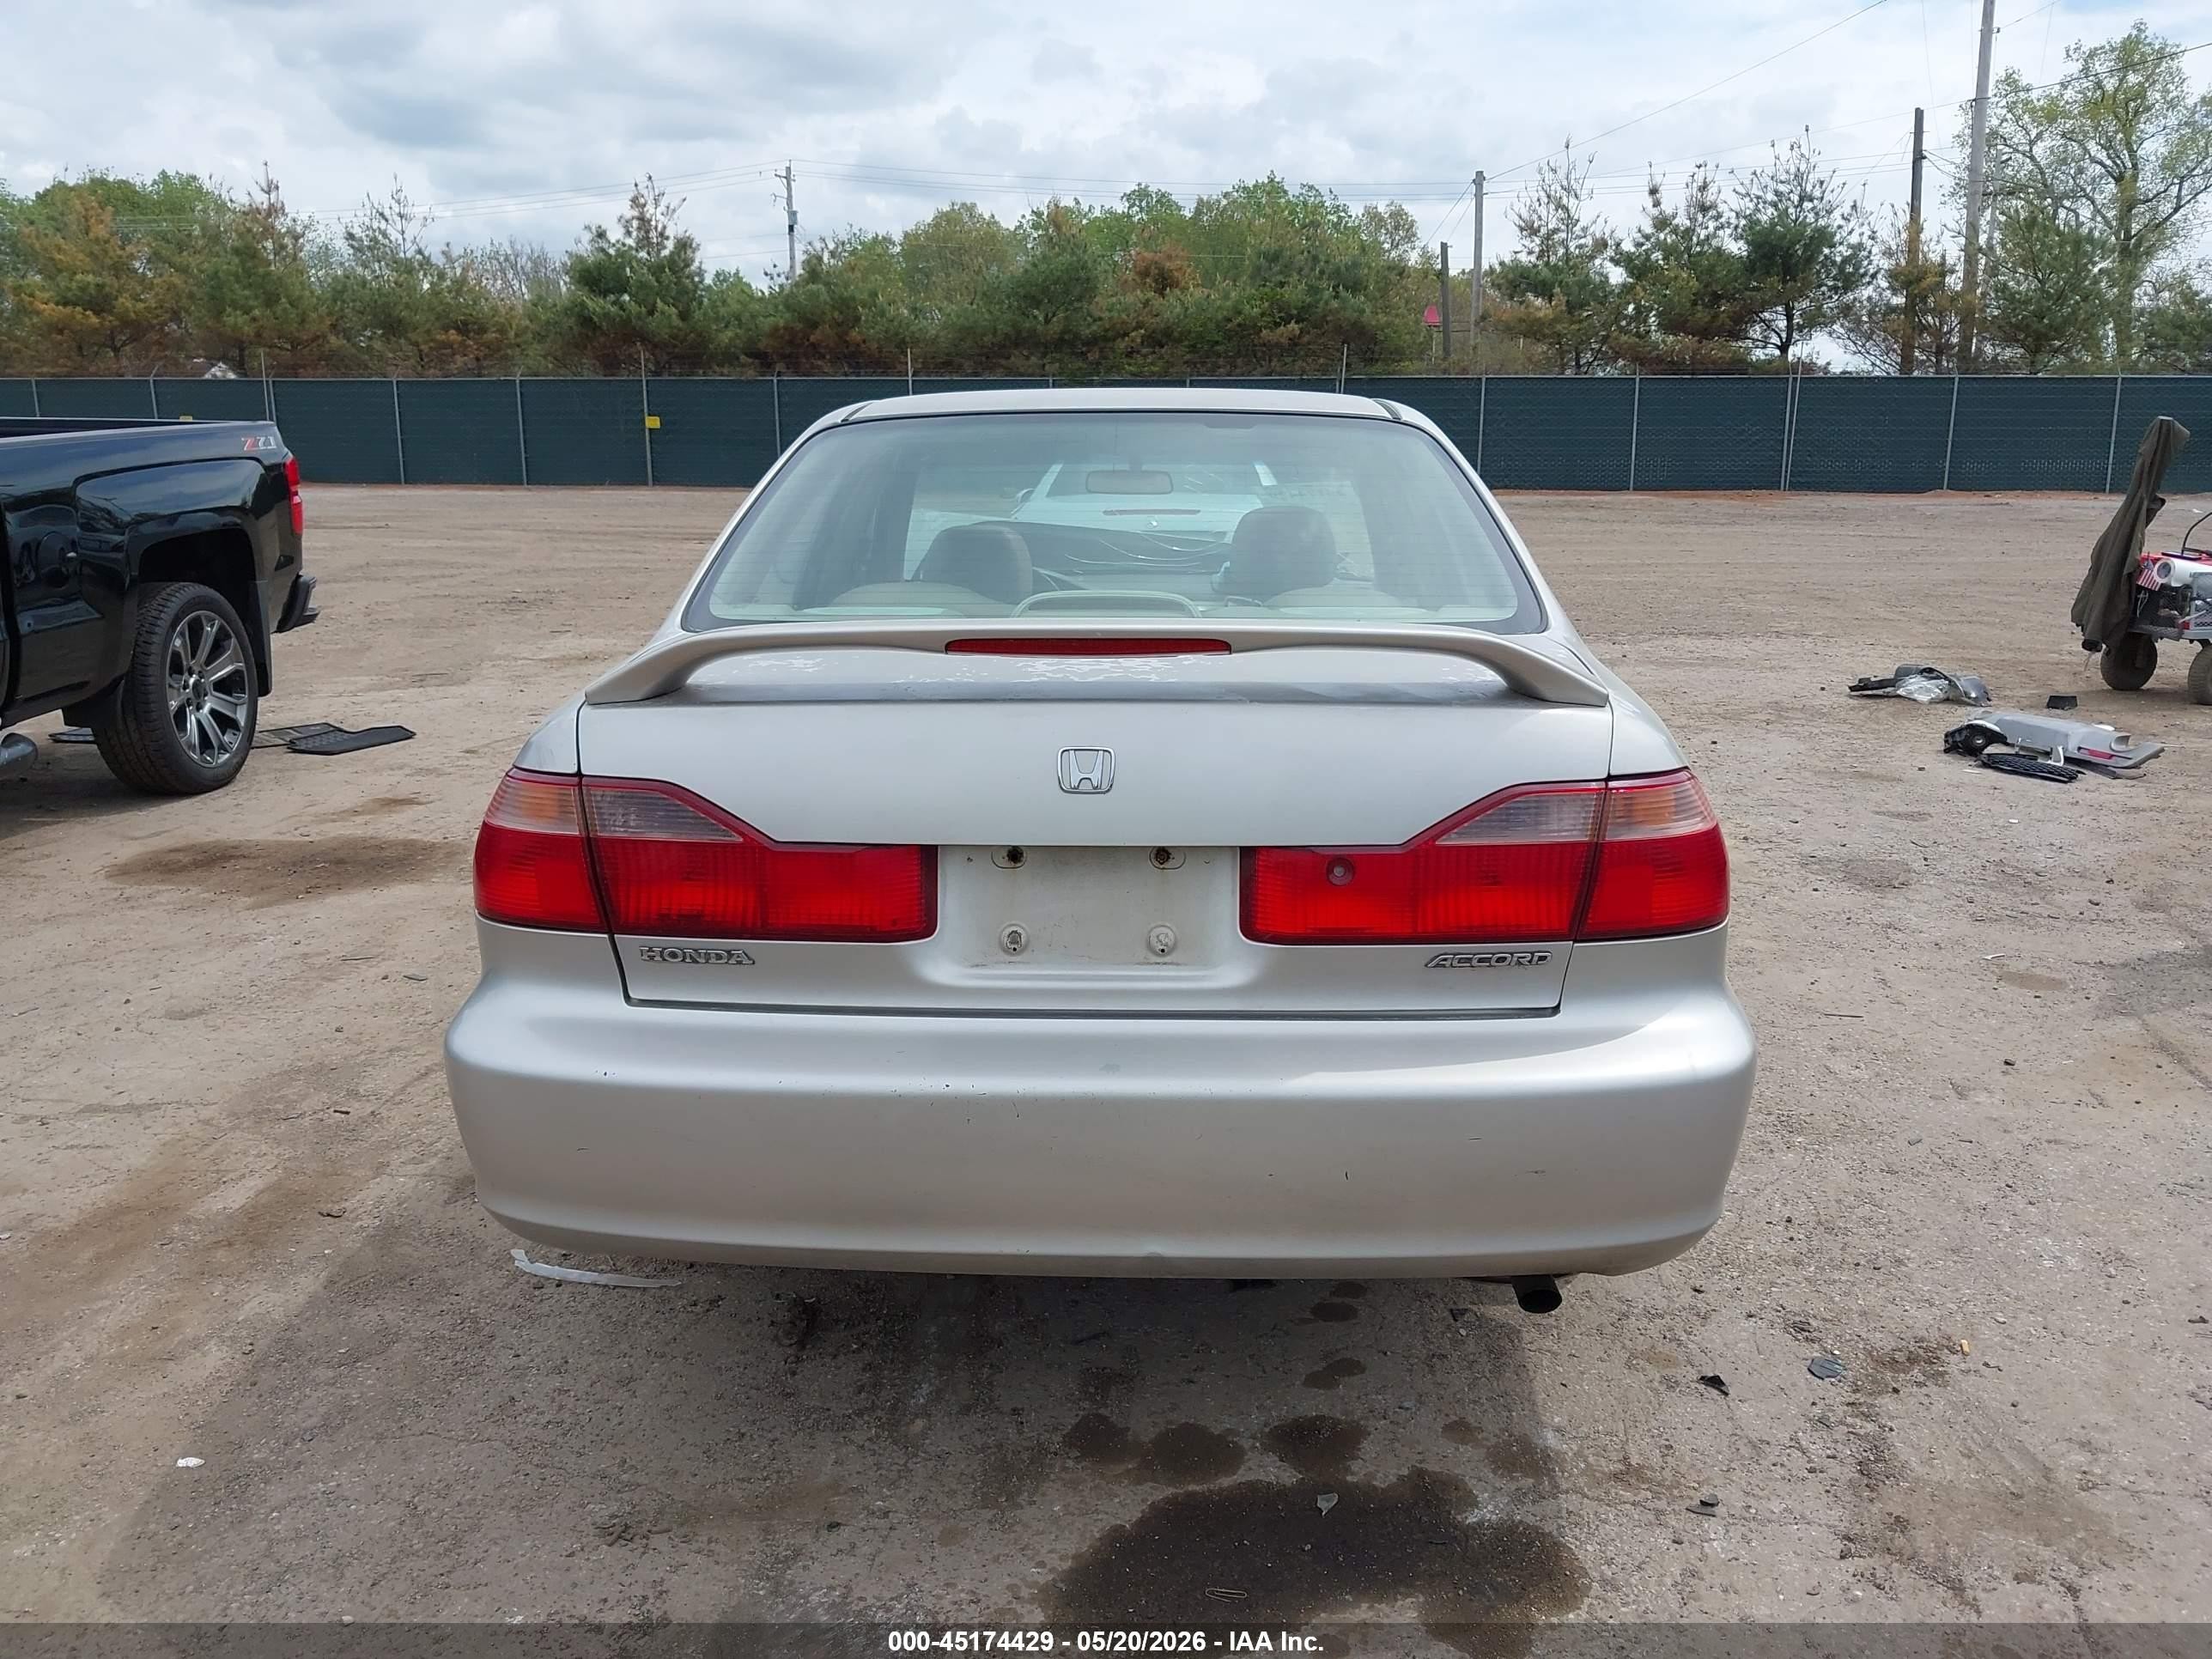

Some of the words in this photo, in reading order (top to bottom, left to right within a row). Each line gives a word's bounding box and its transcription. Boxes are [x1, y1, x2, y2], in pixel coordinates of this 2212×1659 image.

[241, 436, 276, 451] Z71
[639, 945, 756, 965] HONDA
[1425, 951, 1553, 969] ACCORD
